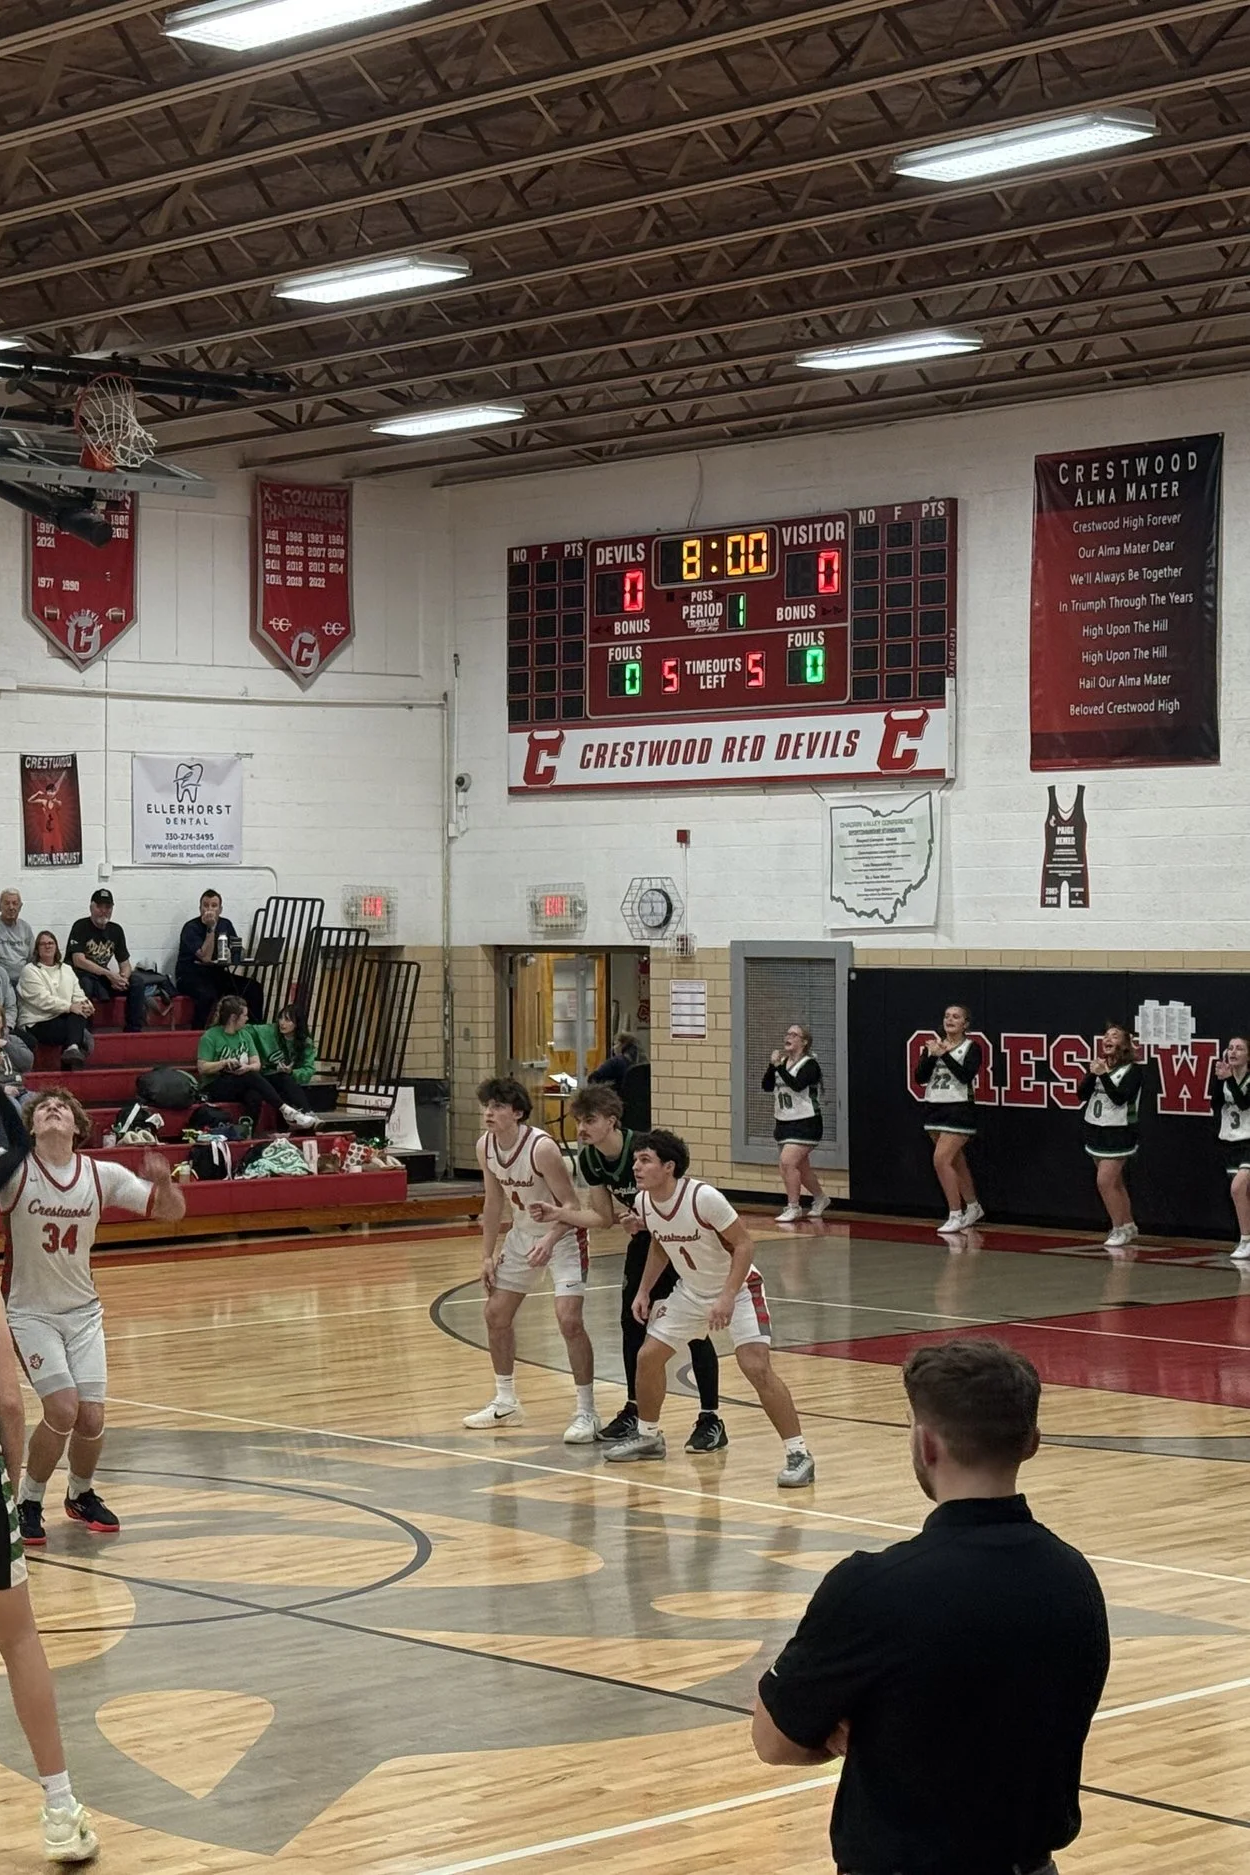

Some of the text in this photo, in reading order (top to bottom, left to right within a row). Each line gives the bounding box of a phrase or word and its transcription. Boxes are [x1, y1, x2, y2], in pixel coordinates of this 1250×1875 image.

[858, 501, 945, 525] NO F PTS
[782, 521, 845, 546] VISITOR
[1072, 513, 1181, 534] Crestwood High Forever
[513, 543, 583, 562] NO F PTS
[596, 543, 645, 566] DEVILS
[682, 530, 768, 580] 8:00
[1078, 540, 1175, 559] Our Alma Mater Dear
[817, 551, 839, 593] 0
[1070, 565, 1183, 586] We'll Always Be Together
[623, 570, 644, 612] 0
[691, 590, 713, 602] POSS
[682, 602, 723, 620] PERIOD
[1058, 591, 1194, 613] In Triumph Through The Years
[776, 604, 816, 622] BONUS
[614, 619, 650, 635] BONUS
[1082, 618, 1169, 640] High Upon The Hill
[787, 631, 825, 648] FOULS
[608, 646, 642, 662] FOULS
[1081, 645, 1168, 666] High Upon The Hill
[685, 656, 742, 675] TIMEOUTS
[747, 653, 763, 687] 5
[806, 648, 824, 684] 0
[625, 663, 640, 695] 0
[662, 660, 678, 692] 5
[699, 674, 726, 690] LEFT
[1079, 673, 1172, 690] Hail Our Alma Mater
[1070, 697, 1180, 716] Beloved Crestwood High
[579, 729, 861, 770] CRESTWOOD RED DEVILS
[25, 756, 72, 769] CRESTWOOD
[146, 804, 232, 815] ELLERHORST
[165, 817, 209, 826] DENTAL
[931, 1072, 951, 1090] 22
[1093, 1099, 1103, 1119] 0
[1230, 1111, 1241, 1130] 3
[28, 1198, 93, 1218] Crestwood
[42, 1222, 78, 1255] 34
[652, 1229, 701, 1242] Crestwood
[679, 1246, 697, 1271] 1
